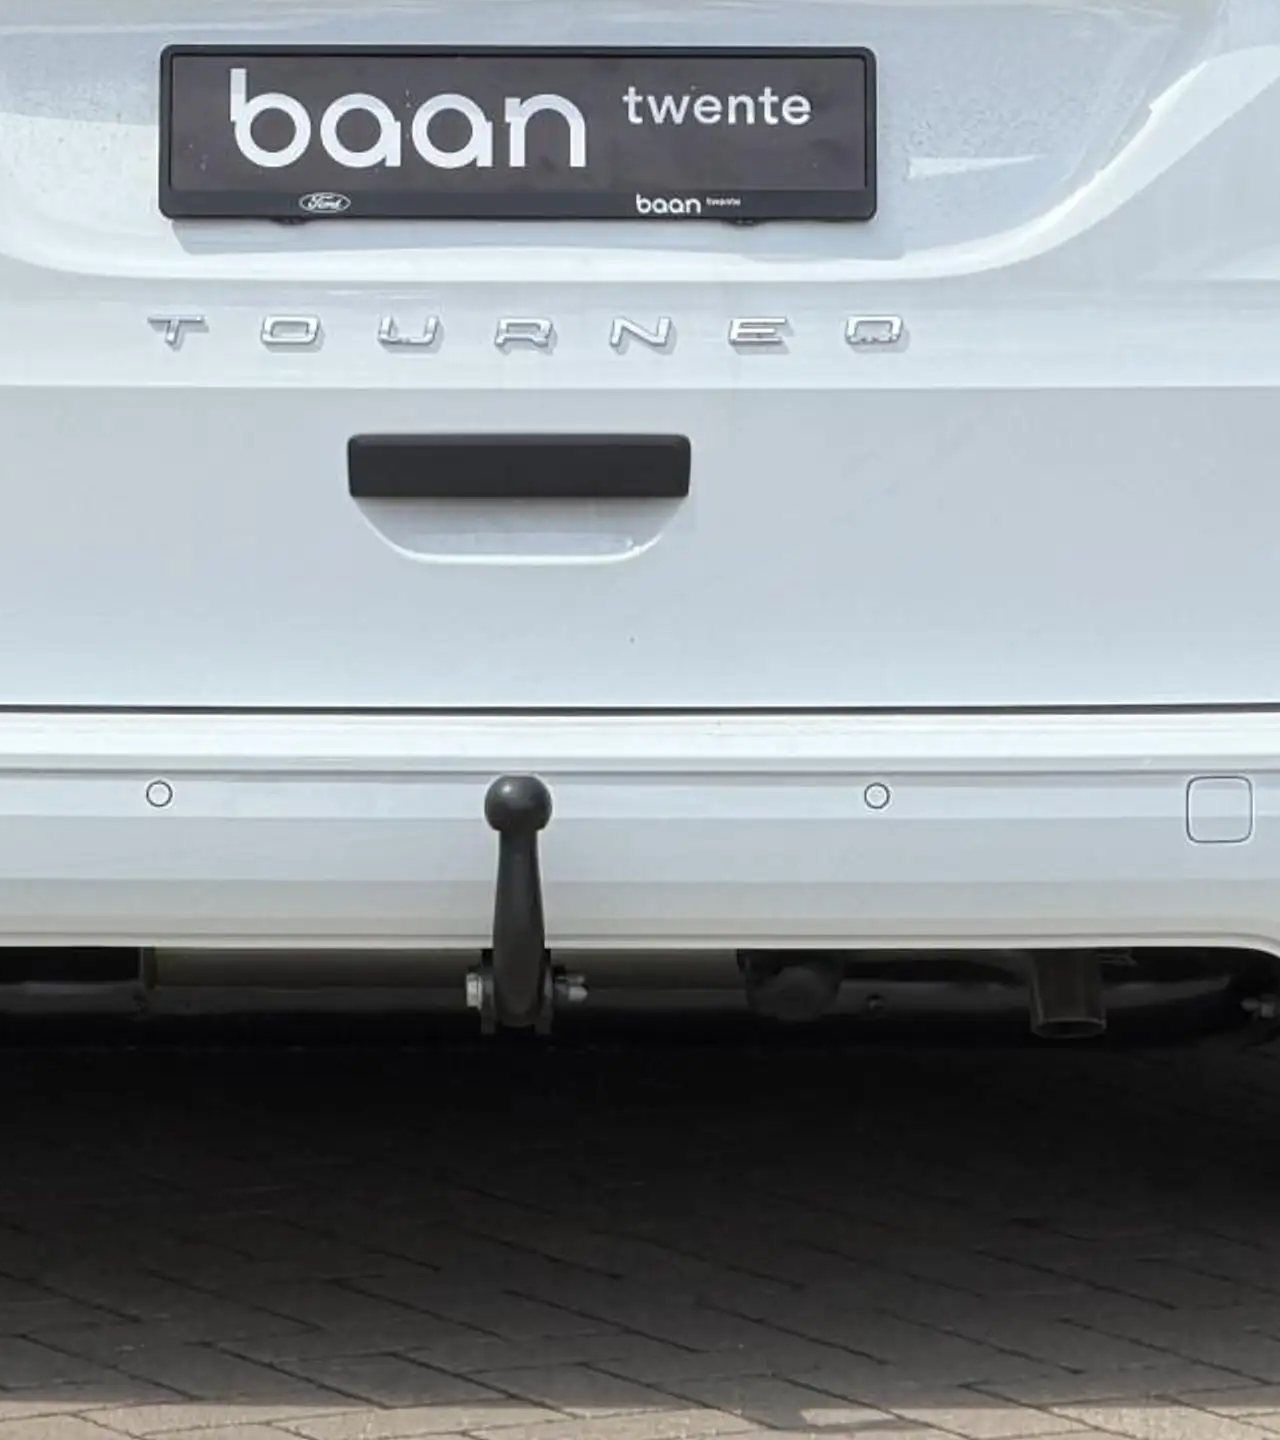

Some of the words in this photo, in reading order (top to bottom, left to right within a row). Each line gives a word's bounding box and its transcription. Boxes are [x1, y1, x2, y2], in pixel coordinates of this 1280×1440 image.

[230, 68, 587, 168] baan
[623, 86, 812, 125] twente
[635, 193, 702, 215] baan
[147, 314, 903, 347] TOURNEO
